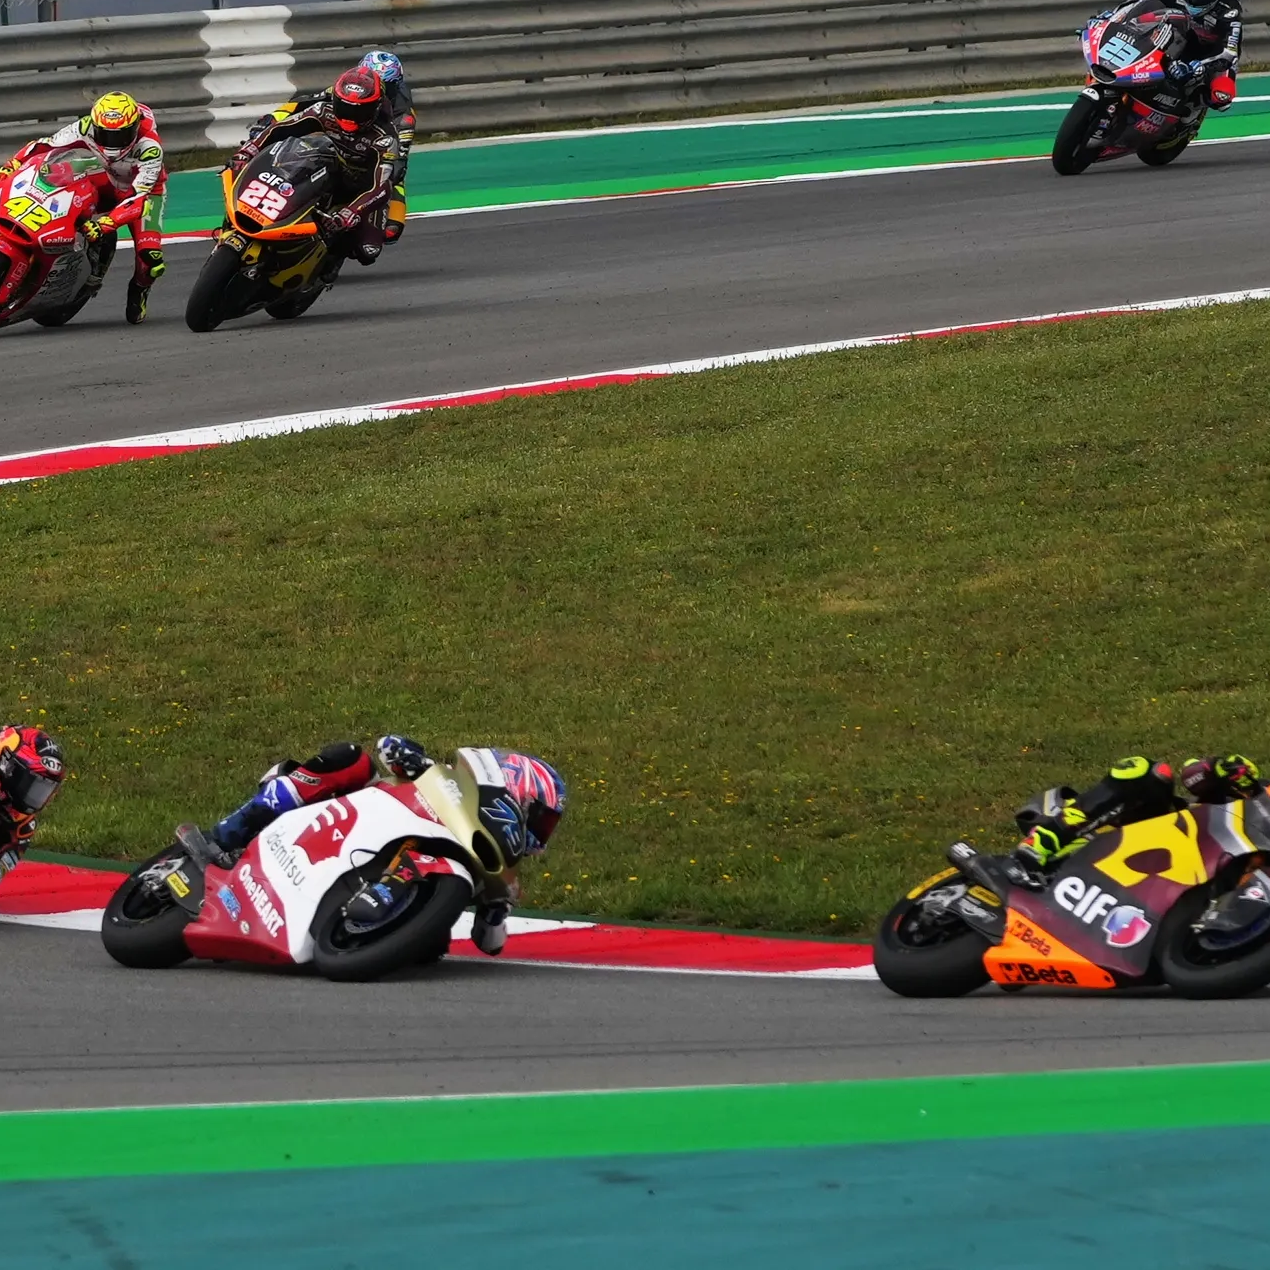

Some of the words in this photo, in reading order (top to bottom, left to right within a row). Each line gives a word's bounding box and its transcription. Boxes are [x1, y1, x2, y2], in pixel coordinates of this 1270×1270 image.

[1099, 36, 1141, 68] 23
[258, 171, 284, 187] elf
[3, 195, 53, 233] 42
[239, 179, 288, 221] 22
[414, 792, 438, 821] HONDA
[265, 824, 306, 887] idemitsu
[1054, 876, 1118, 924] elf
[1020, 929, 1052, 957] Beta
[1022, 963, 1078, 984] Beta
